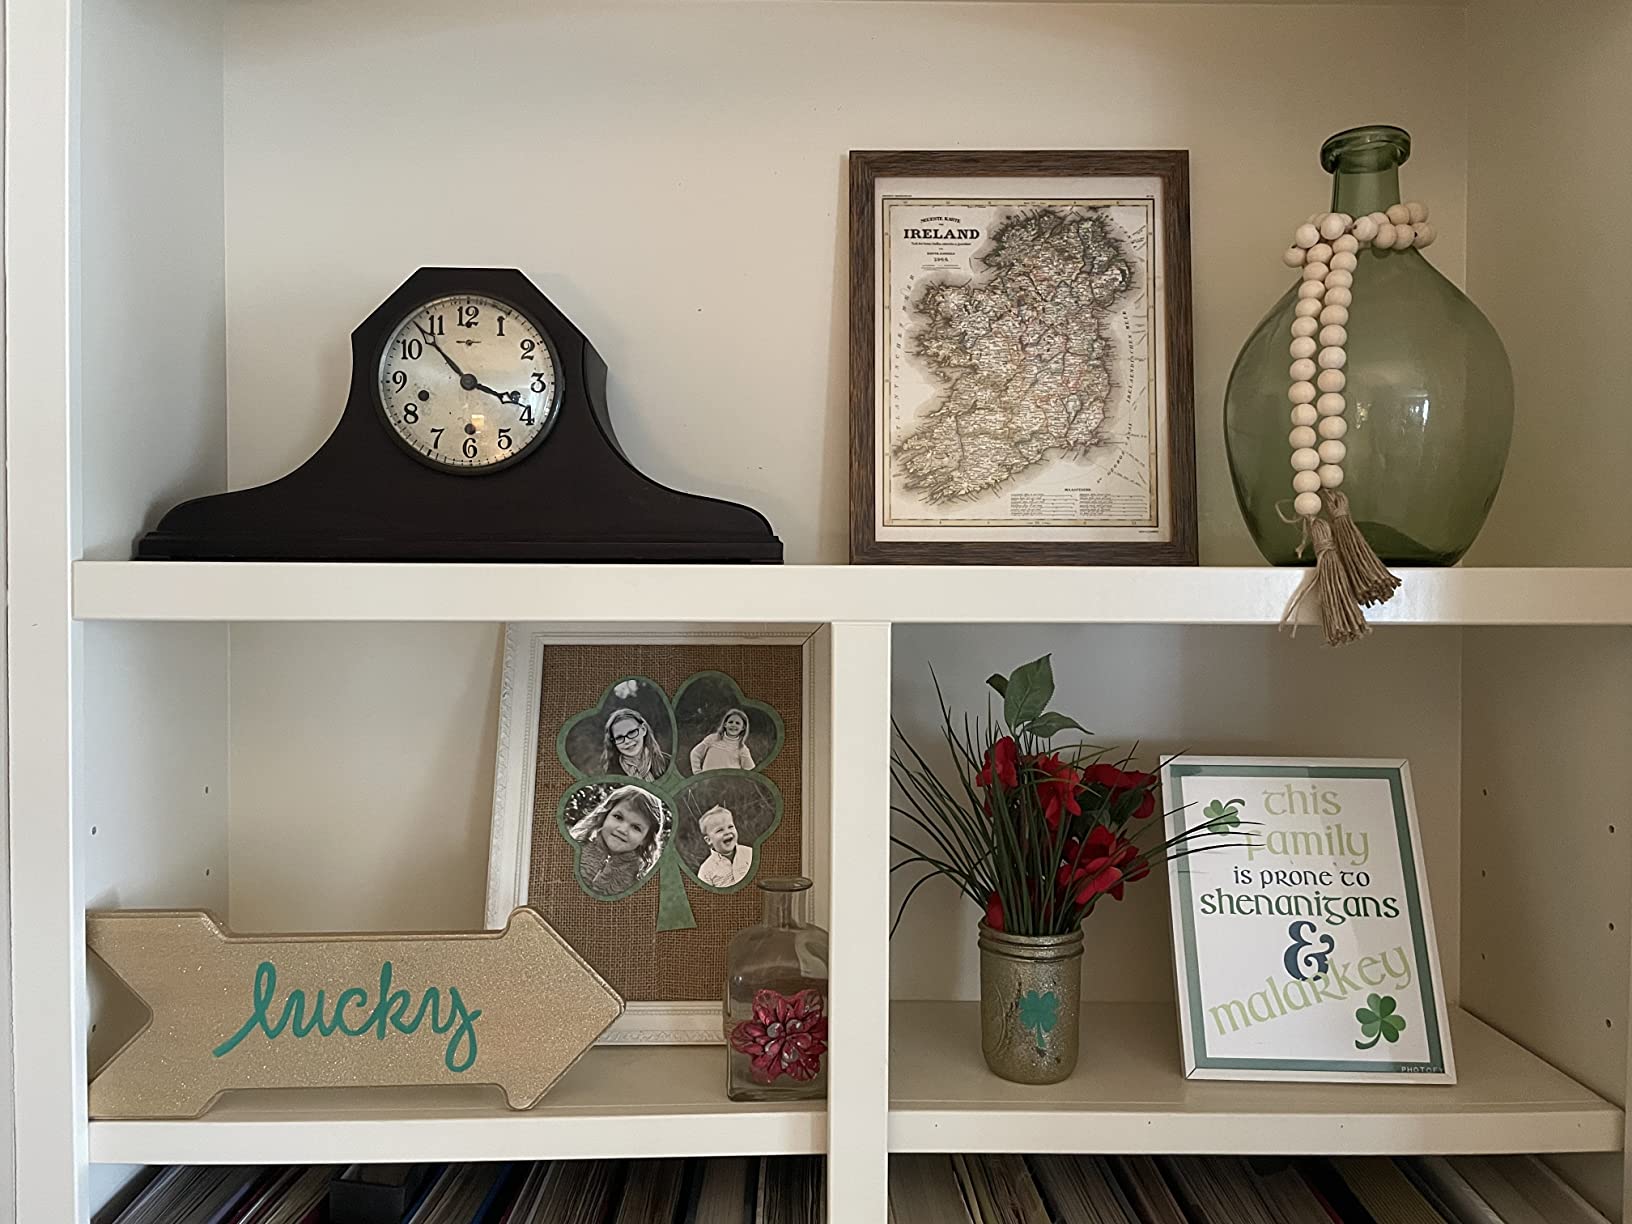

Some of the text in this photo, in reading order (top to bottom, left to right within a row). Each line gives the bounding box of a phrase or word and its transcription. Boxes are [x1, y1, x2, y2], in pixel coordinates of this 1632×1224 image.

[904, 229, 980, 239] IRELAND
[428, 315, 444, 336] 11
[456, 306, 479, 328] 12
[496, 316, 506, 336] 1
[401, 339, 422, 360] 10
[520, 339, 535, 360] 2
[392, 371, 407, 393] 9
[531, 373, 546, 393] 3
[404, 403, 418, 424] 8
[519, 405, 535, 426] 4
[431, 428, 445, 449] 7
[463, 438, 478, 458] 6
[498, 428, 512, 450] 5
[1263, 784, 1342, 816] this
[1246, 823, 1370, 867] family
[1234, 865, 1253, 884] is
[1340, 870, 1370, 886] to
[1200, 888, 1400, 926] shenanigans
[1283, 919, 1335, 982] &
[1209, 945, 1412, 1037] malarkey
[212, 960, 483, 1073] lucky
